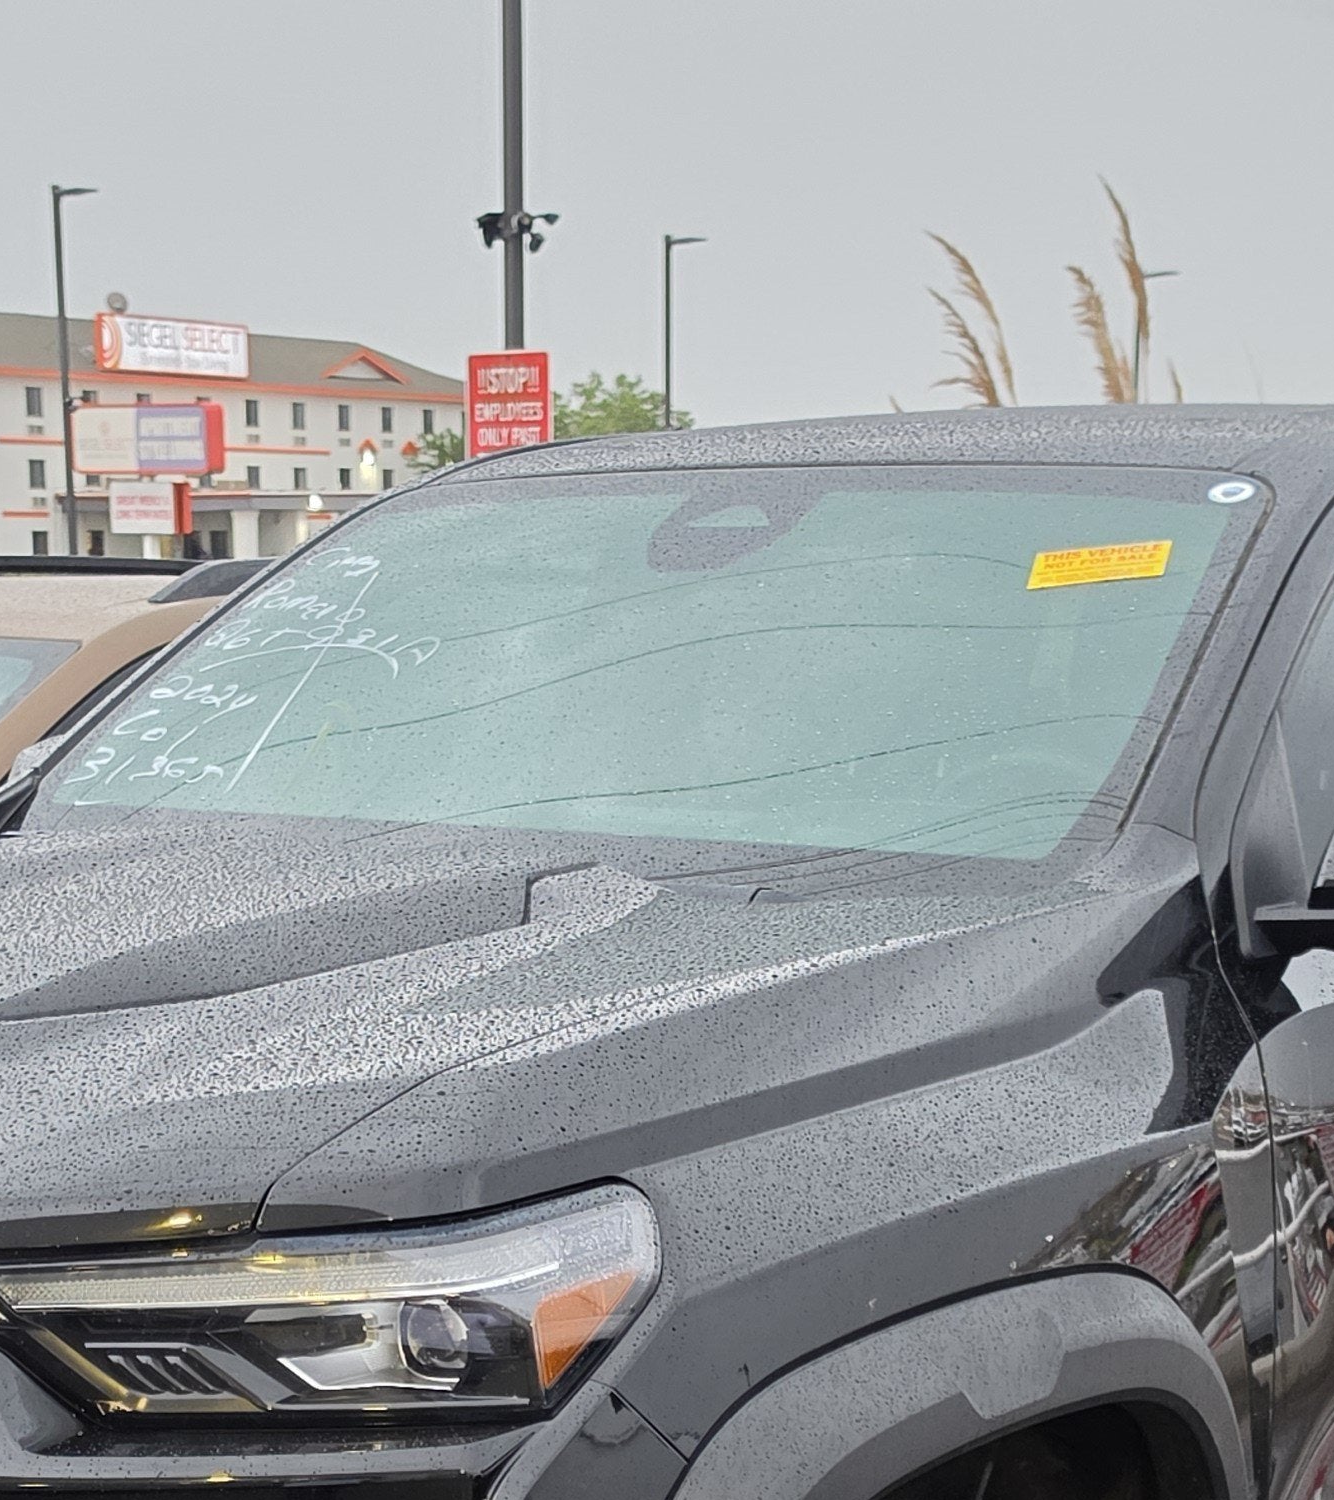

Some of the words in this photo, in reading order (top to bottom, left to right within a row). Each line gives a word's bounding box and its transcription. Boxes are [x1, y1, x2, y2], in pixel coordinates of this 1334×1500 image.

[182, 326, 241, 355] SELECT
[474, 402, 544, 423] EMPLOYEES
[477, 427, 509, 447] ONLY
[1043, 551, 1082, 562] THIS
[1087, 543, 1164, 558] VEHICLE
[1043, 560, 1074, 570] NOT
[1080, 557, 1112, 566] FOR
[1117, 552, 1158, 562] SALE
